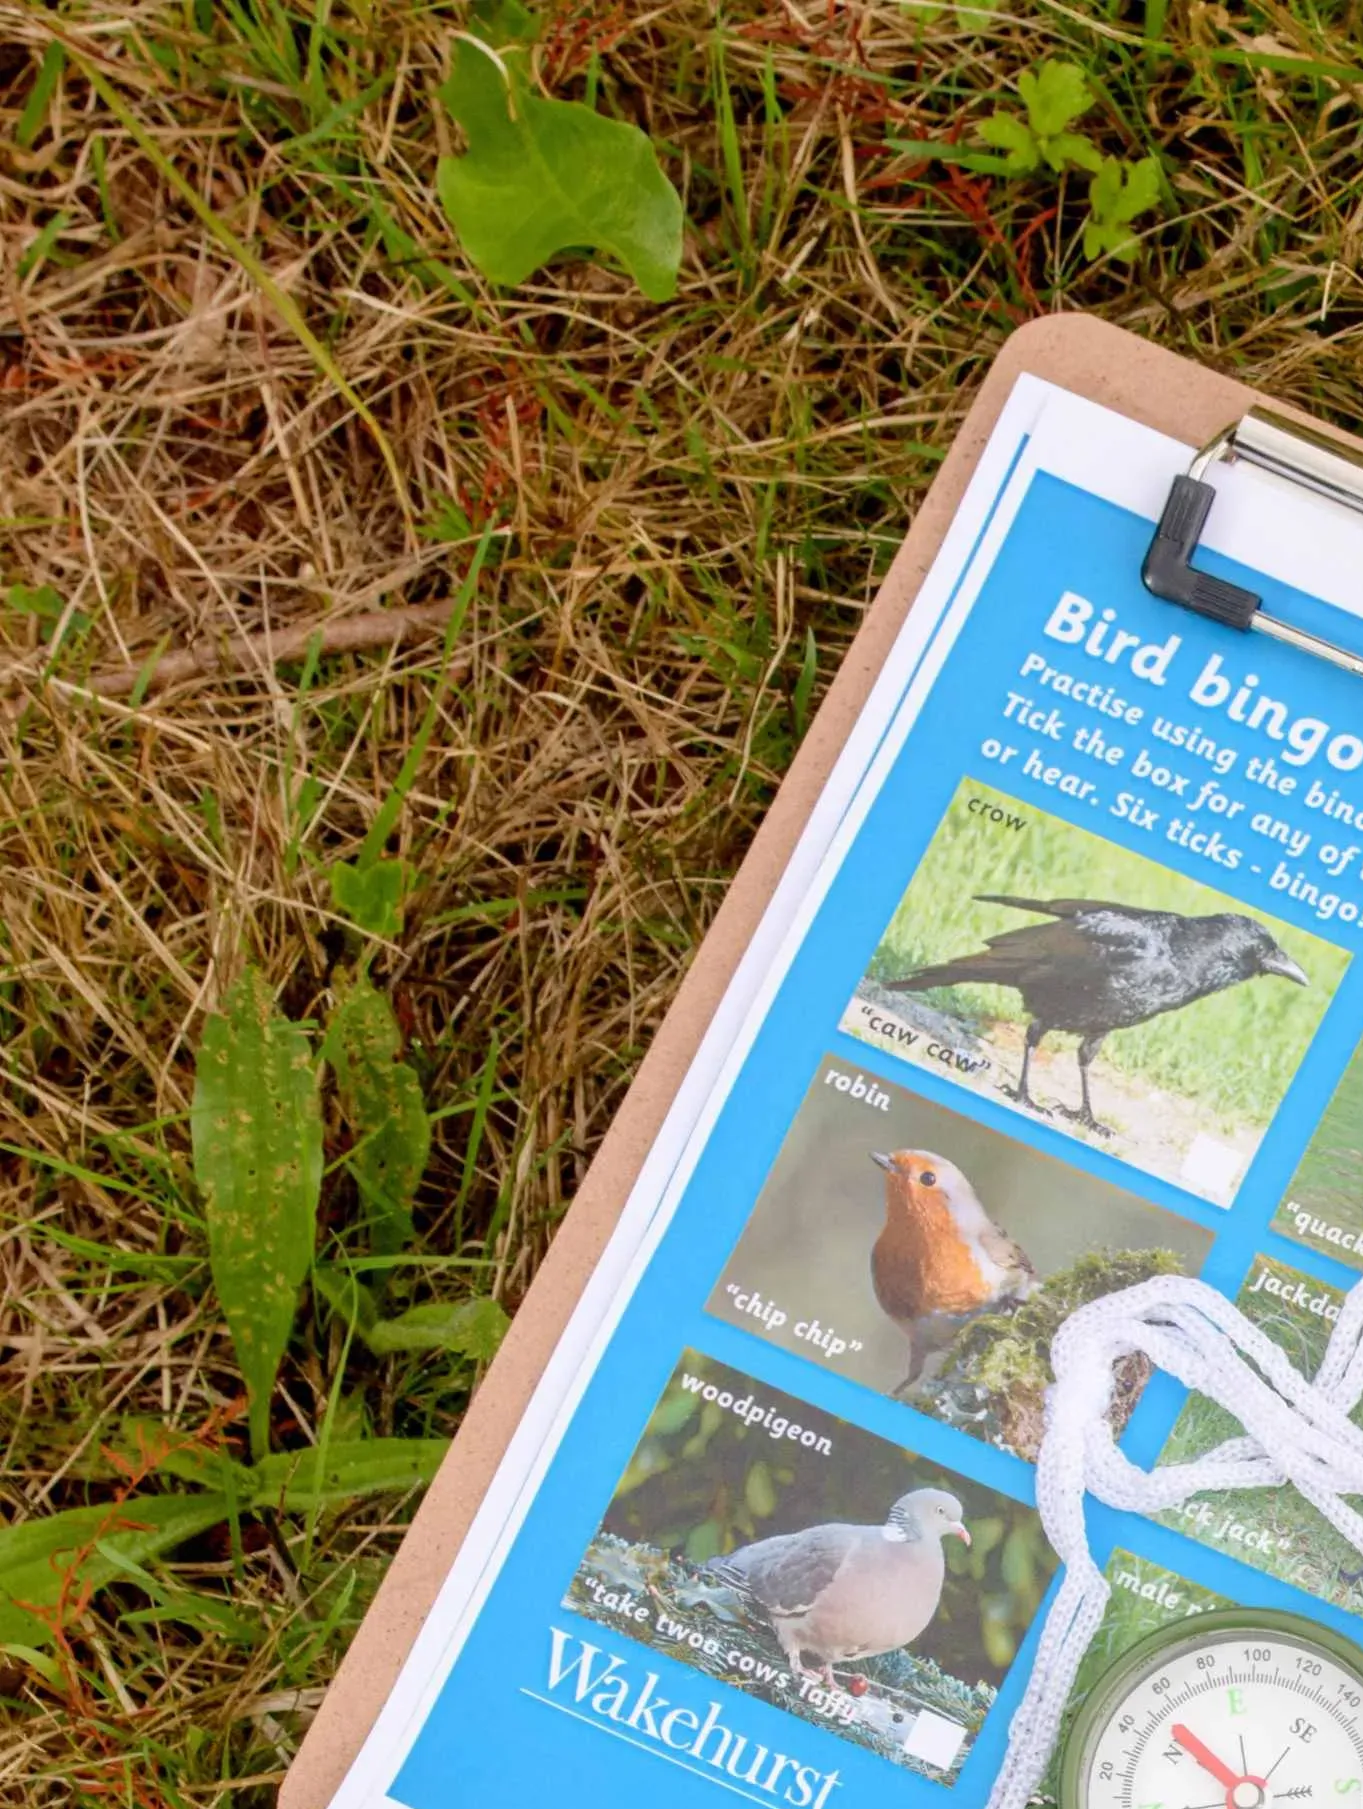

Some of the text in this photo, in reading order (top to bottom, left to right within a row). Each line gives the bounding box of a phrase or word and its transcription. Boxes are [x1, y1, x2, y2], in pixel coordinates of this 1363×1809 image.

[1043, 591, 1182, 686] Bird
[1019, 653, 1144, 725] Practise
[1151, 716, 1238, 775] using
[1246, 756, 1298, 796] the
[1003, 693, 1065, 740] Tick
[1072, 727, 1124, 766] the
[1130, 749, 1190, 796] box
[1186, 780, 1245, 818] for
[1250, 813, 1311, 858] any
[1318, 844, 1360, 877] of
[967, 797, 1027, 833] crow
[981, 738, 1018, 764] or
[1022, 749, 1100, 807] hear.
[1109, 791, 1159, 831] Six
[1166, 818, 1243, 869] ticks
[823, 1067, 891, 1112] robin
[680, 1371, 833, 1457] woodpigeon
[1116, 1570, 1185, 1610] male
[726, 1645, 792, 1688] cows
[1195, 1653, 1216, 1671] 80
[1242, 1648, 1272, 1663] 100
[1294, 1655, 1324, 1677] 120
[1150, 1675, 1172, 1697] 60
[1226, 1687, 1247, 1717] E
[1335, 1682, 1362, 1709] 140
[1116, 1713, 1136, 1735] 40
[1288, 1716, 1319, 1745] SE
[1098, 1759, 1115, 1782] 20
